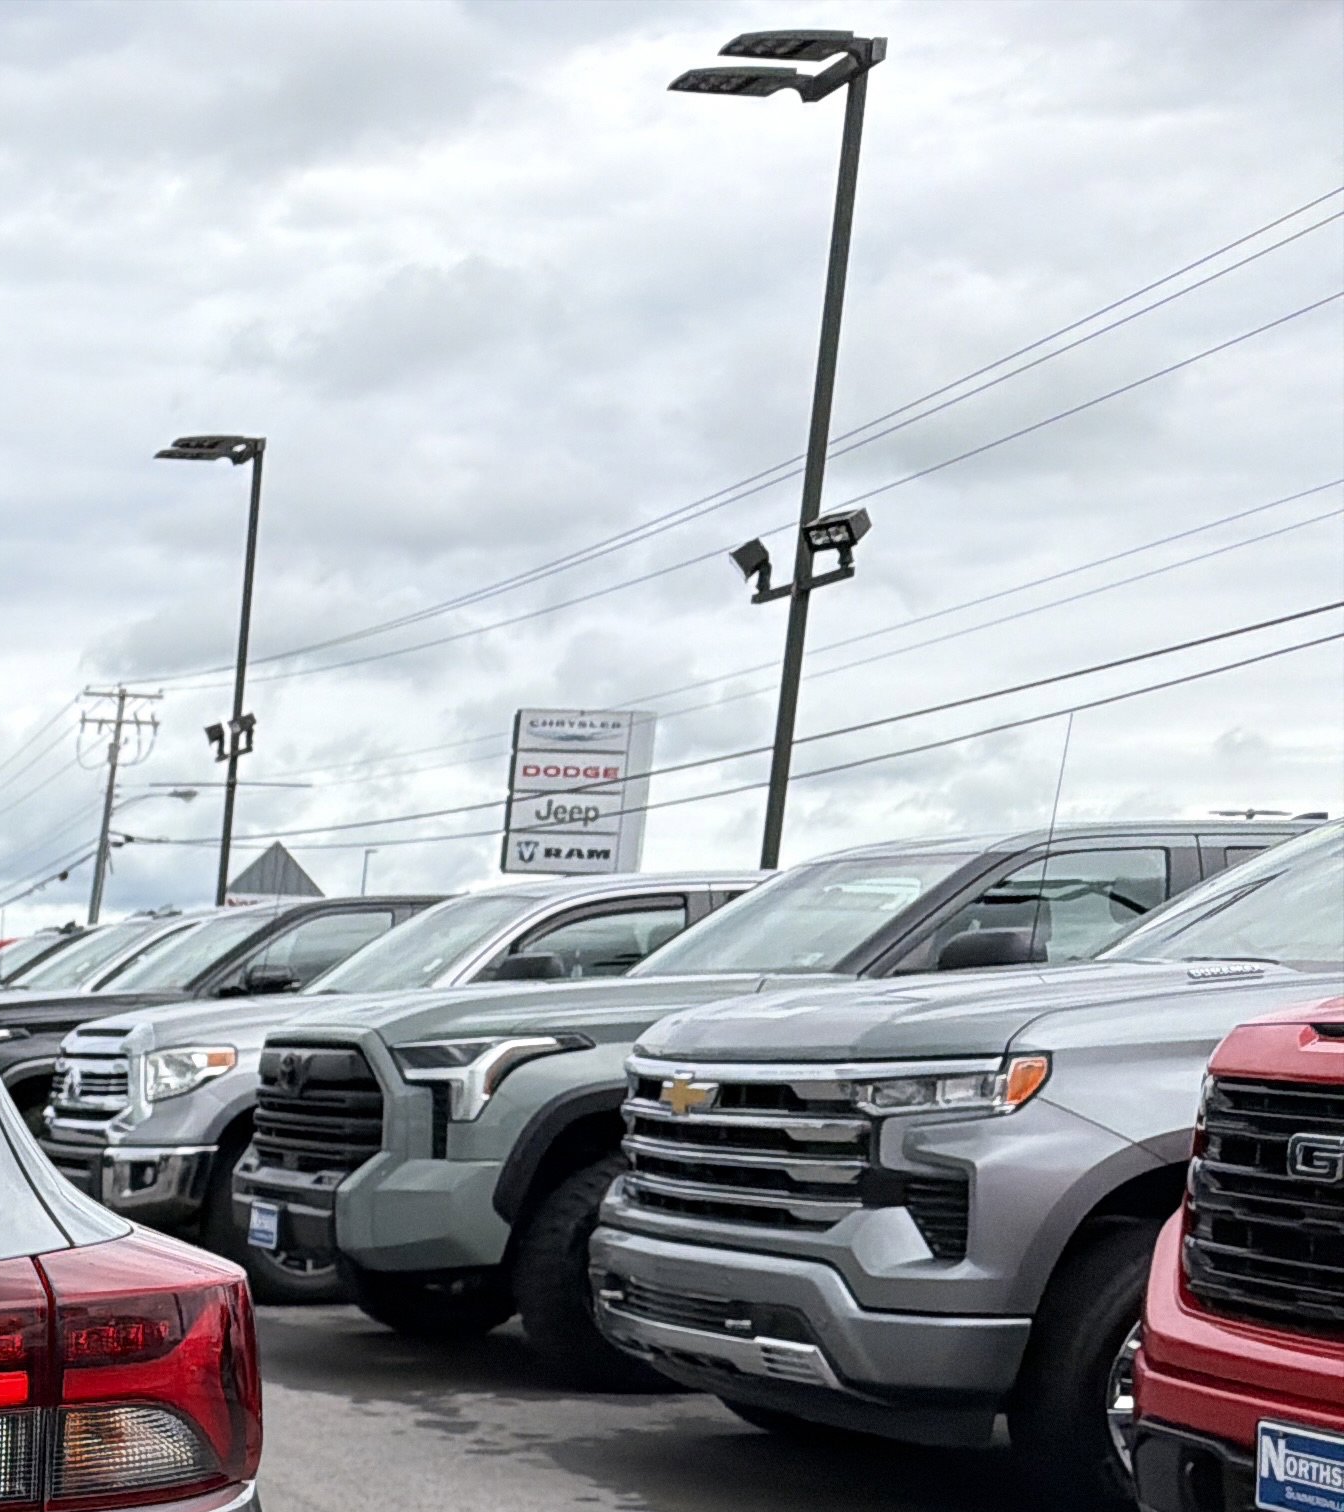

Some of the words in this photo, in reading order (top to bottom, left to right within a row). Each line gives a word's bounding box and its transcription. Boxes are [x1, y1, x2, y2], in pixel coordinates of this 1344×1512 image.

[529, 719, 621, 729] CHRYSLER
[523, 765, 619, 779] DODGE
[534, 798, 600, 827] Jeep
[544, 848, 611, 860] RAM
[1260, 1434, 1344, 1487] NORTHS
